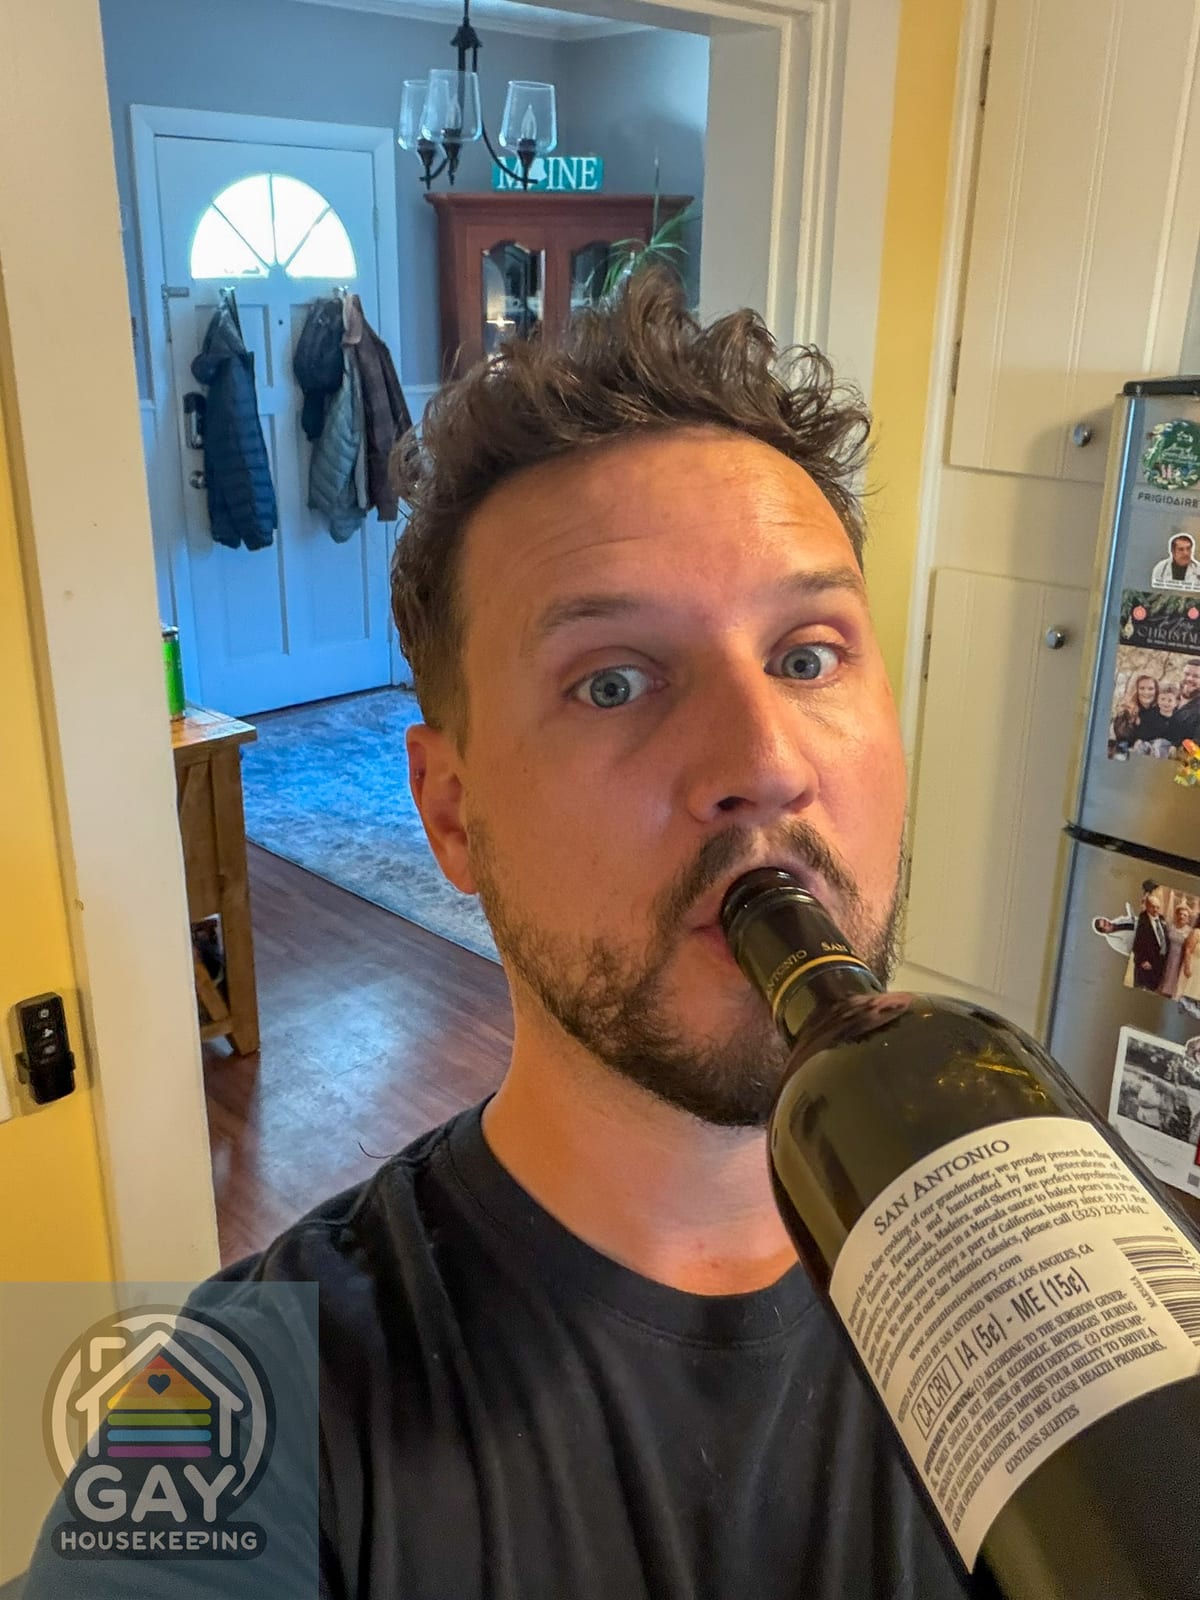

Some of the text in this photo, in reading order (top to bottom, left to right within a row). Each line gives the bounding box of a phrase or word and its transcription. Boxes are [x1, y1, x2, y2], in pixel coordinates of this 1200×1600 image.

[1137, 491, 1199, 508] FRIGIDAIRE
[857, 1283, 867, 1297] by
[864, 1270, 875, 1286] the
[883, 1225, 912, 1257] cooking
[910, 1212, 921, 1228] of
[919, 1203, 935, 1220] our
[935, 1171, 996, 1210] grandmother,
[994, 1163, 1010, 1174] we
[1010, 1152, 1047, 1171] proudly
[1047, 1149, 1081, 1161] present
[874, 1140, 1010, 1235] SAN ANTONIO
[880, 1287, 892, 1306] our
[903, 1241, 937, 1272] Marsala,
[934, 1214, 973, 1242] Madeira,
[972, 1199, 992, 1216] and
[989, 1187, 1023, 1207] Sherry
[1022, 1182, 1038, 1193] are
[1039, 1173, 1073, 1190] perfect
[889, 1231, 922, 1269] Flavorful
[925, 1212, 943, 1232] and
[945, 1179, 1002, 1216] handcrafted
[1005, 1173, 1021, 1184] by
[1024, 1165, 1047, 1177] four
[885, 1297, 901, 1321] from
[897, 1267, 924, 1301] braised
[922, 1242, 954, 1273] chicken
[953, 1235, 964, 1246] in
[963, 1230, 971, 1238] a
[969, 1209, 1008, 1234] Marsala
[1007, 1197, 1033, 1213] sauce
[1034, 1193, 1047, 1203] to
[1045, 1184, 1077, 1199] baked
[896, 1300, 915, 1325] invite
[913, 1285, 928, 1306] you
[926, 1276, 937, 1288] to
[936, 1257, 960, 1279] enjoy
[959, 1251, 967, 1260] a
[966, 1236, 987, 1256] part
[987, 1226, 999, 1241] of
[998, 1208, 1045, 1234] California
[1043, 1199, 1080, 1214] history
[1079, 1195, 1105, 1206] since
[910, 1256, 1022, 1360] www.sanantoniowinery.com
[913, 1311, 924, 1326] on
[922, 1296, 937, 1315] our
[934, 1282, 951, 1300] San
[949, 1257, 983, 1287] Antonio
[981, 1235, 1023, 1261] Classics,
[1021, 1221, 1053, 1241] please
[1052, 1212, 1072, 1227] call
[1071, 1206, 1102, 1222] (323)
[930, 1342, 942, 1359] BY
[938, 1328, 954, 1348] SAN
[952, 1299, 986, 1334] ANTONIO
[983, 1277, 1022, 1304] WINERY,
[1018, 1265, 1039, 1282] LOS
[1037, 1248, 1081, 1273] ANGELES,
[1078, 1243, 1094, 1255] CA
[916, 1396, 936, 1428] CA
[927, 1365, 953, 1408] CRV
[971, 1313, 1008, 1357] (5¢)
[1010, 1287, 1046, 1322] ME
[1039, 1267, 1090, 1308] (15¢)
[946, 1387, 977, 1425] WARNING:
[972, 1374, 986, 1393] (1)
[984, 1340, 1026, 1381] ACCORDING
[1022, 1331, 1038, 1346] TO
[1035, 1320, 1057, 1337] THE
[1054, 1300, 1096, 1327] SURGEON
[1094, 1290, 1127, 1308] GENER-
[967, 1398, 983, 1419] NOT
[982, 1375, 1007, 1403] DRINK
[1006, 1342, 1051, 1380] ALCOHOLIC
[1050, 1315, 1100, 1347] BEVERAGES
[1100, 1301, 1138, 1322] DURING
[972, 1419, 984, 1437] OF
[980, 1405, 997, 1426] THE
[993, 1390, 1013, 1412] RISK
[1010, 1381, 1022, 1397] OF
[1020, 1362, 1048, 1388] BIRTH
[1044, 1341, 1085, 1370] DEFECTS.
[1084, 1331, 1102, 1347] (2)
[1099, 1315, 1145, 1339] CONSUMP-
[979, 1408, 1017, 1451] BEVERAGES
[1014, 1381, 1048, 1414] IMPAIRS
[1044, 1365, 1072, 1388] YOUR
[1070, 1346, 1105, 1373] ABILITY
[1102, 1340, 1120, 1354] TO
[1118, 1329, 1150, 1348] DRIVE
[1147, 1326, 1159, 1338] A
[980, 1428, 1021, 1475] MACHINERY,
[1017, 1413, 1035, 1434] AND
[1033, 1397, 1053, 1419] MAY
[1051, 1379, 1081, 1404] CAUSE
[1078, 1360, 1115, 1387] HEALTH
[1113, 1340, 1167, 1368] PROBLEMS.
[1005, 1404, 1080, 1474] CONTAINS SULFITES
